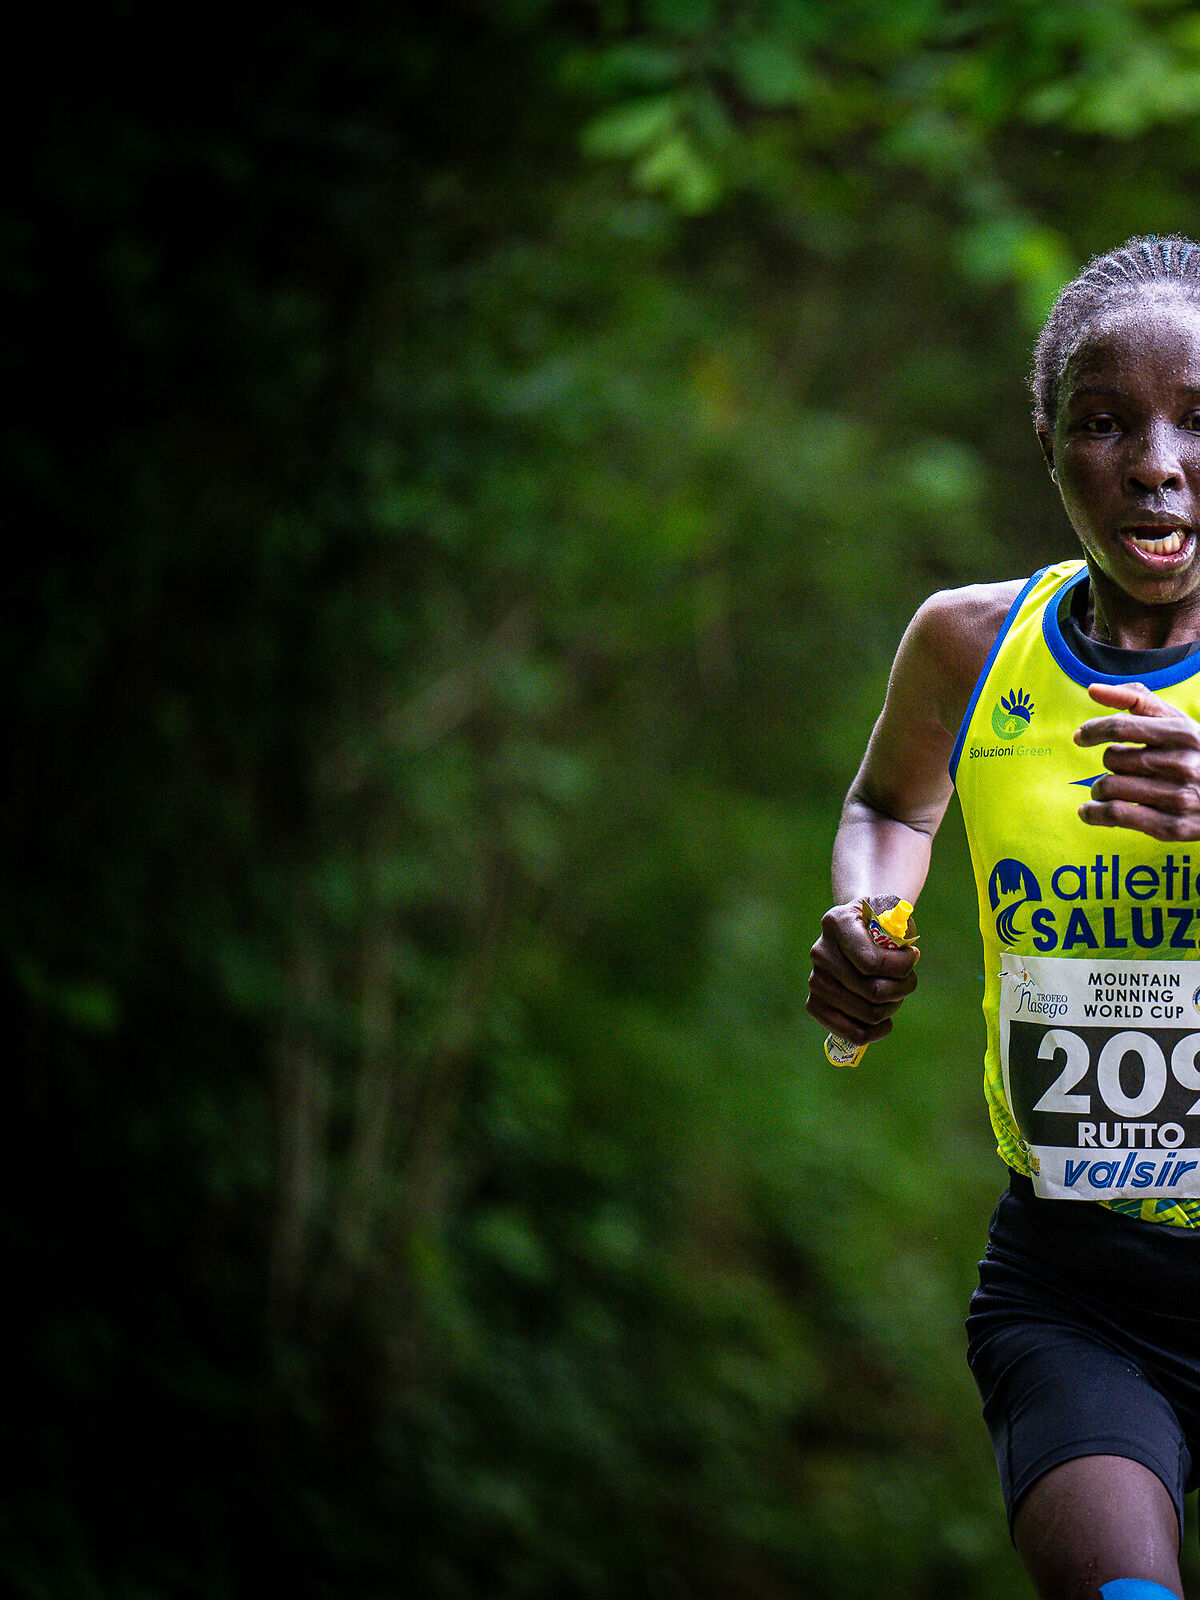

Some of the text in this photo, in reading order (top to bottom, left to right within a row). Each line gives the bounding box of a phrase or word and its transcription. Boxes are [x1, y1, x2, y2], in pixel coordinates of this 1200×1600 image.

[969, 745, 1052, 759] Soluzioni Green
[1088, 972, 1180, 987] MOUNTAIN
[1037, 993, 1068, 1003] TROFEO
[1095, 988, 1174, 1003] RUNNING
[1084, 1004, 1184, 1019] WORLD CUP
[1078, 1122, 1186, 1149] RUTTO
[1063, 1151, 1200, 1188] valsir
